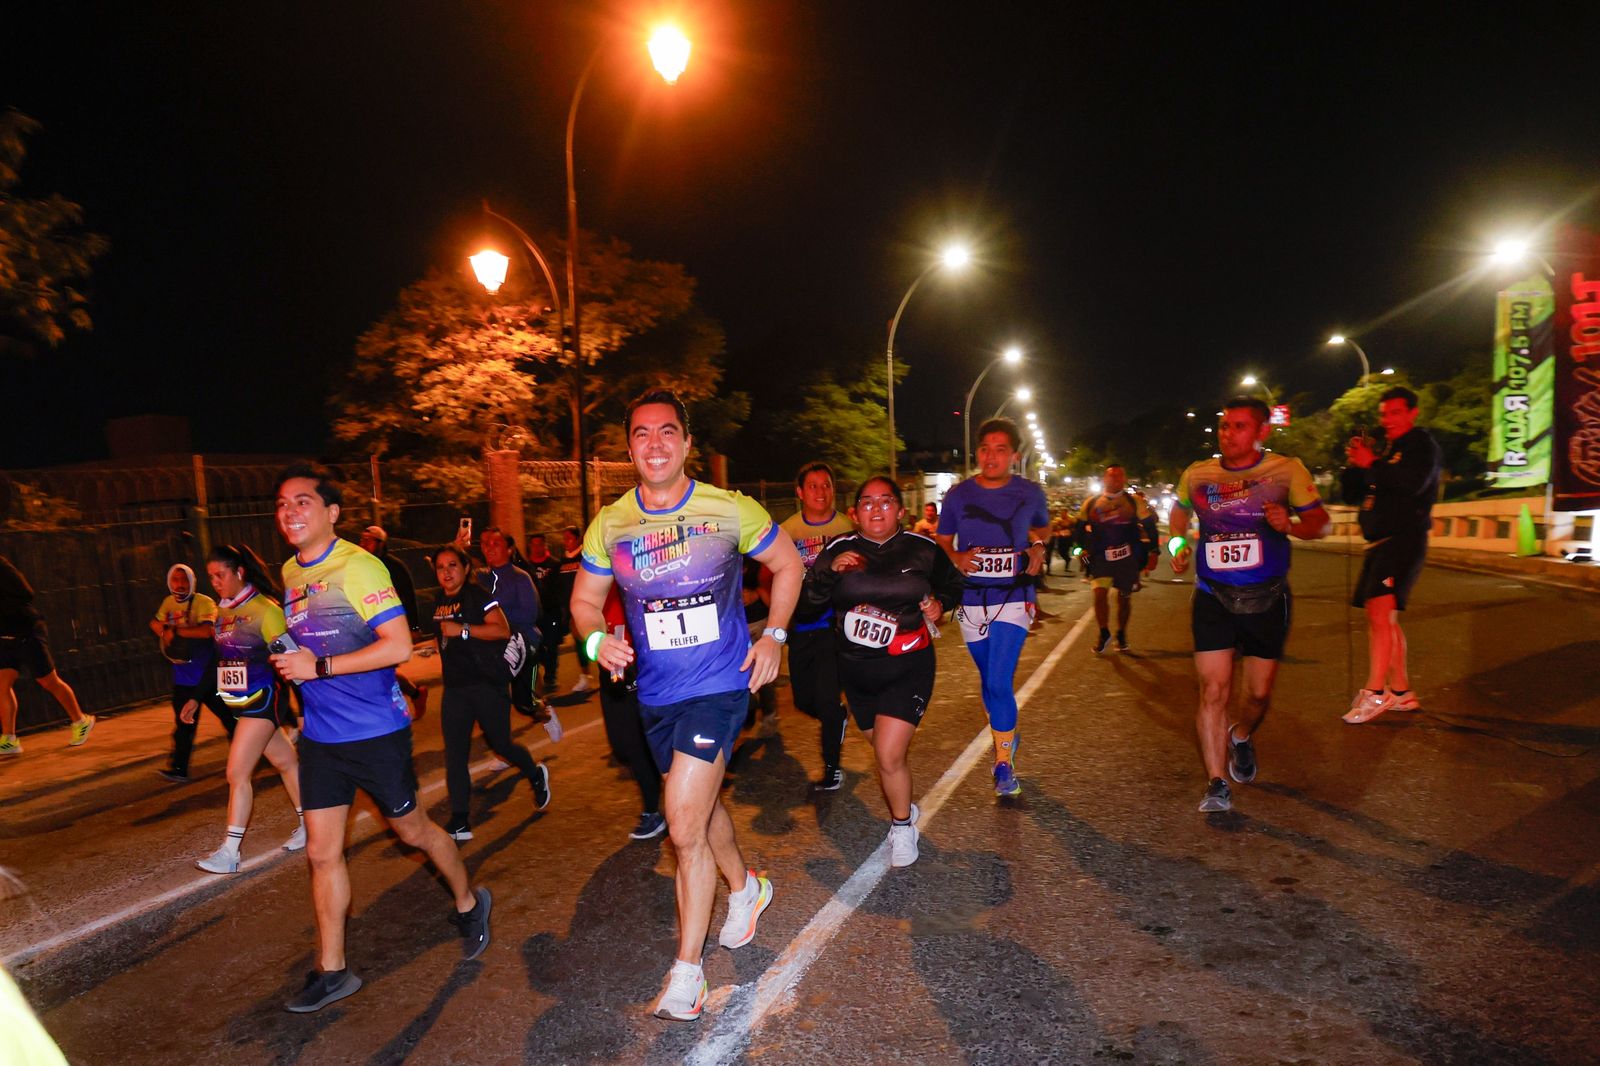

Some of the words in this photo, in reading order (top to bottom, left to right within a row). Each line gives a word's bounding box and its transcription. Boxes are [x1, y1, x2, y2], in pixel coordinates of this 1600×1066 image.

[1511, 302, 1530, 331] FM
[632, 525, 680, 556] CARRERA
[634, 540, 691, 571] NOCTURNA
[1220, 544, 1251, 563] 657
[677, 612, 687, 635] 1
[853, 618, 892, 645] 1850
[670, 635, 699, 647] FELIFER
[222, 670, 244, 685] 4651
